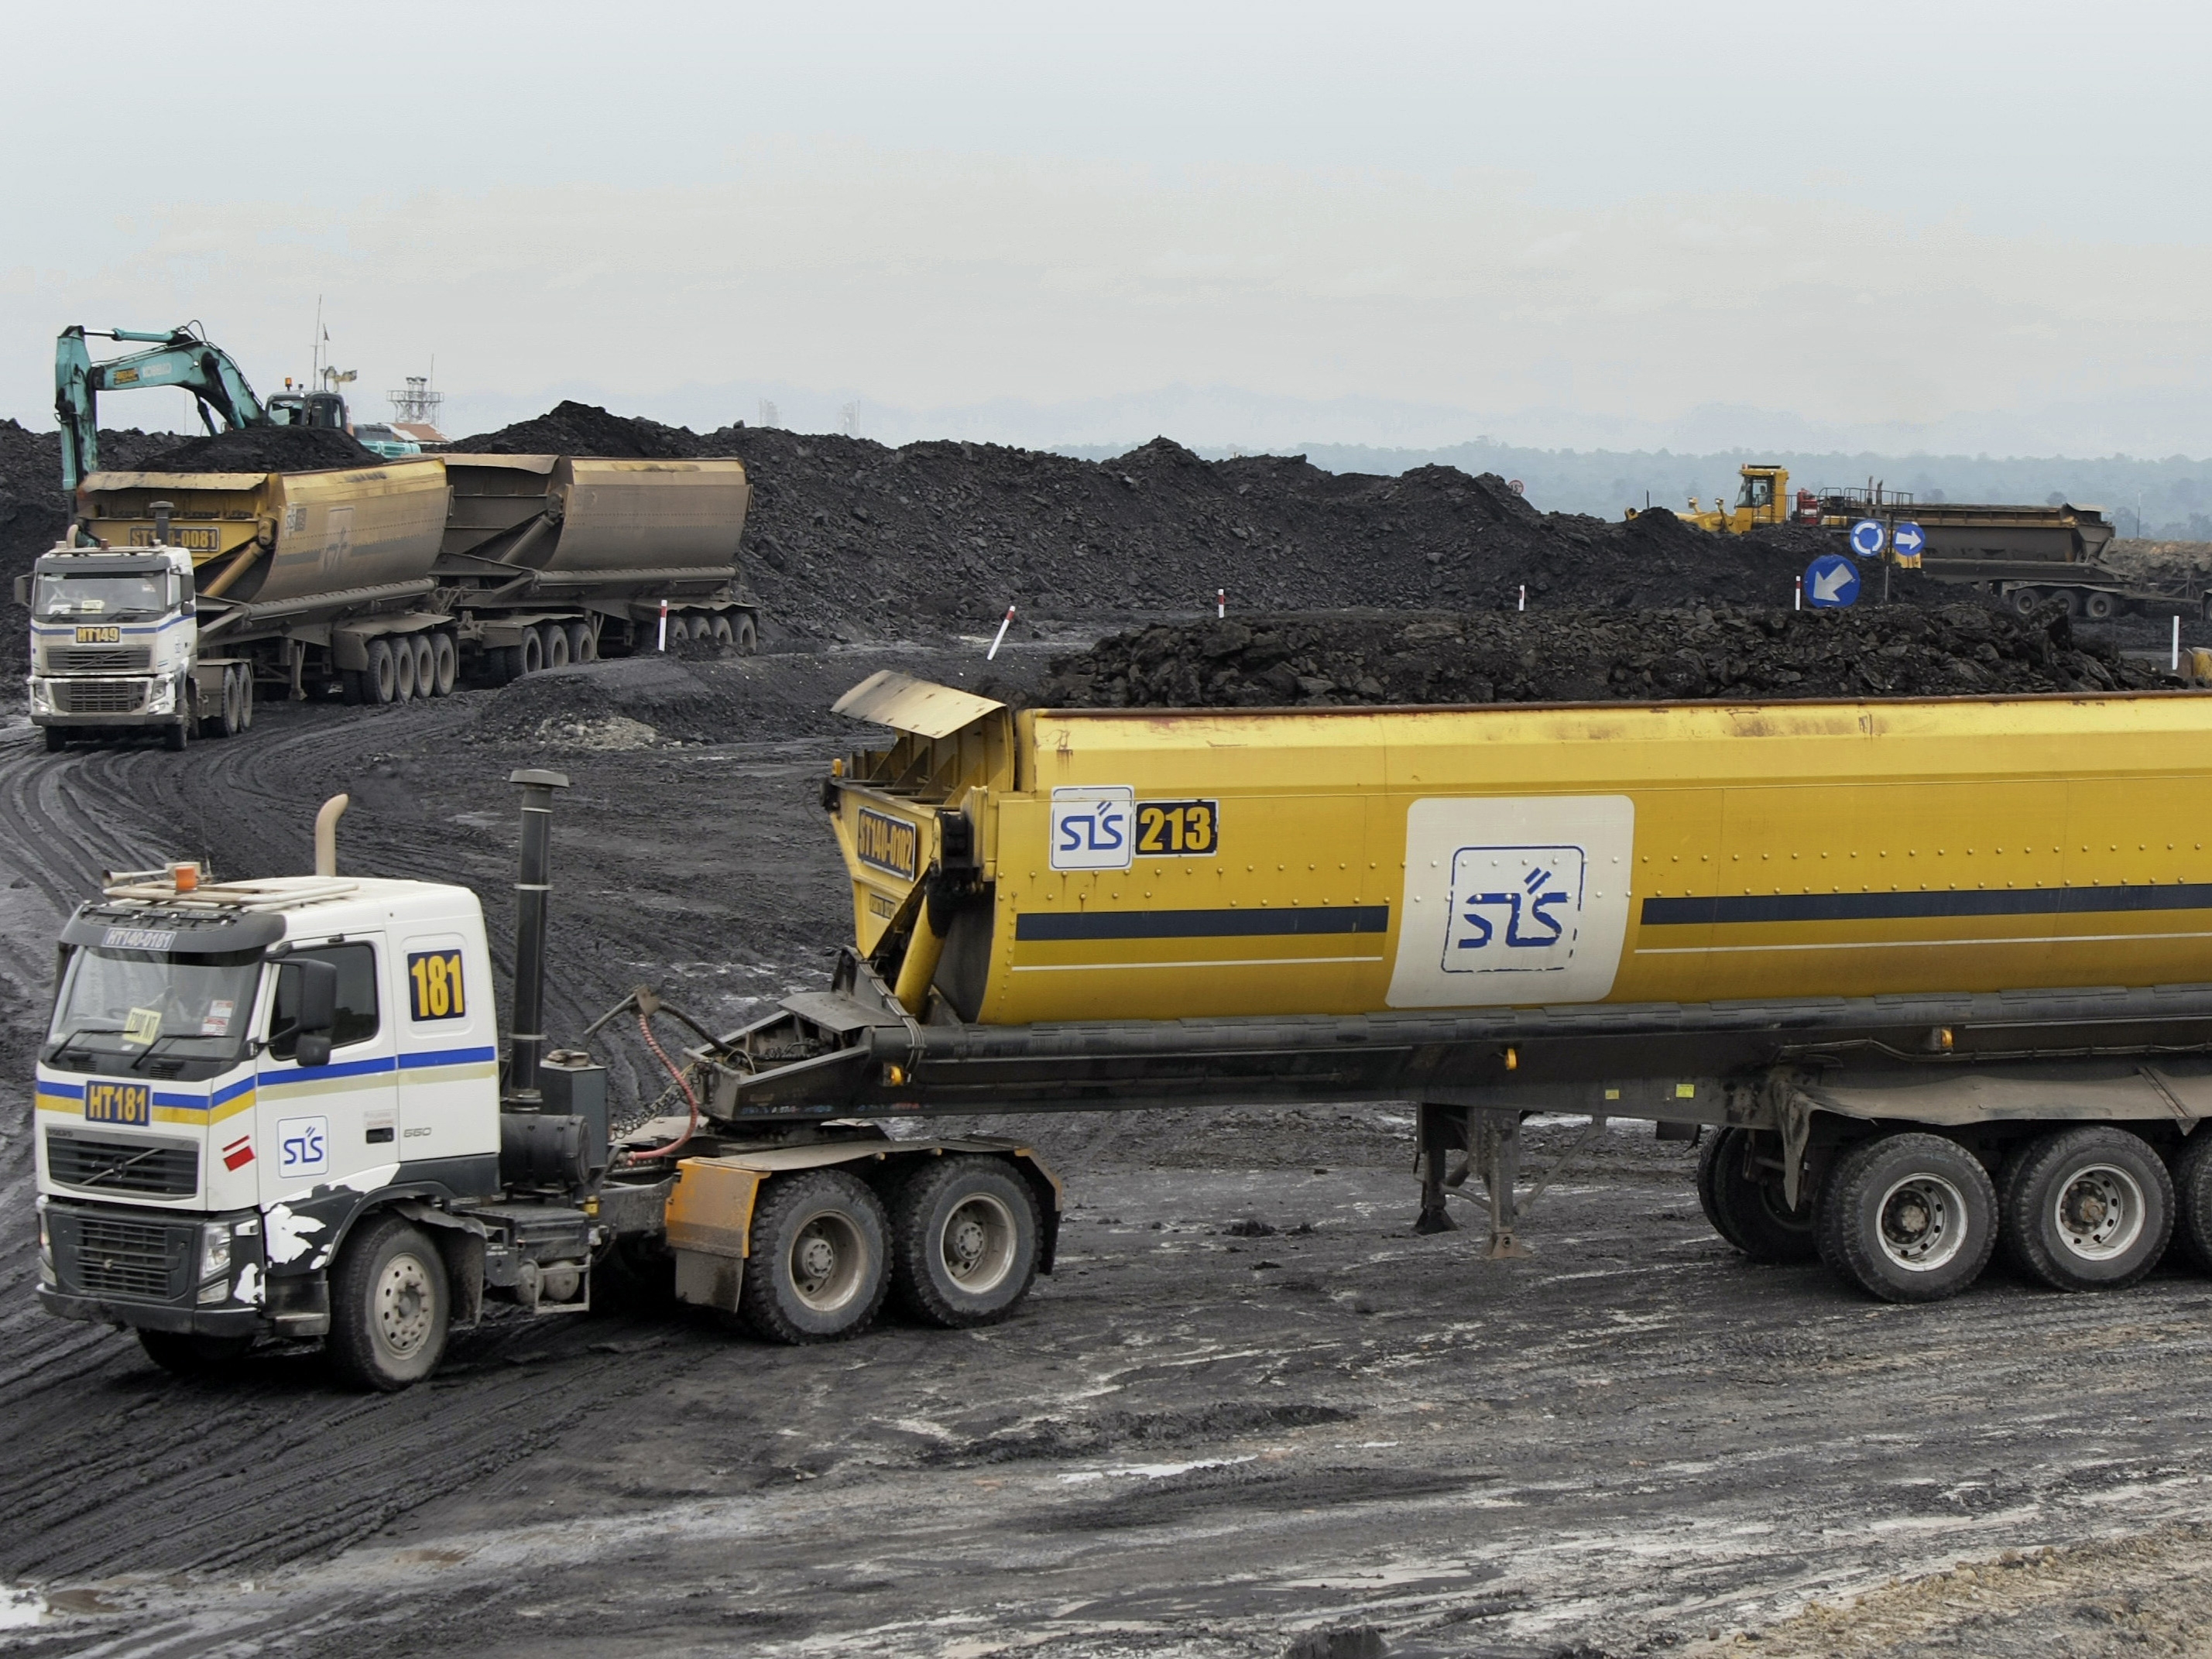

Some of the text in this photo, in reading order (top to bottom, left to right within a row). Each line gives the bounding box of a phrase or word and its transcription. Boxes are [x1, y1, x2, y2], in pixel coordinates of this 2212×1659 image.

[132, 530, 216, 547] ST10-0081
[77, 628, 118, 643] HT149
[1060, 801, 1123, 851] SLS
[1139, 807, 1211, 850] 213
[1458, 867, 1570, 949] SLS
[105, 930, 173, 949] HT140-0181
[411, 954, 464, 1016] 181
[88, 1085, 146, 1122] HT181
[283, 1126, 323, 1164] SLS
[403, 1127, 432, 1138] 660
